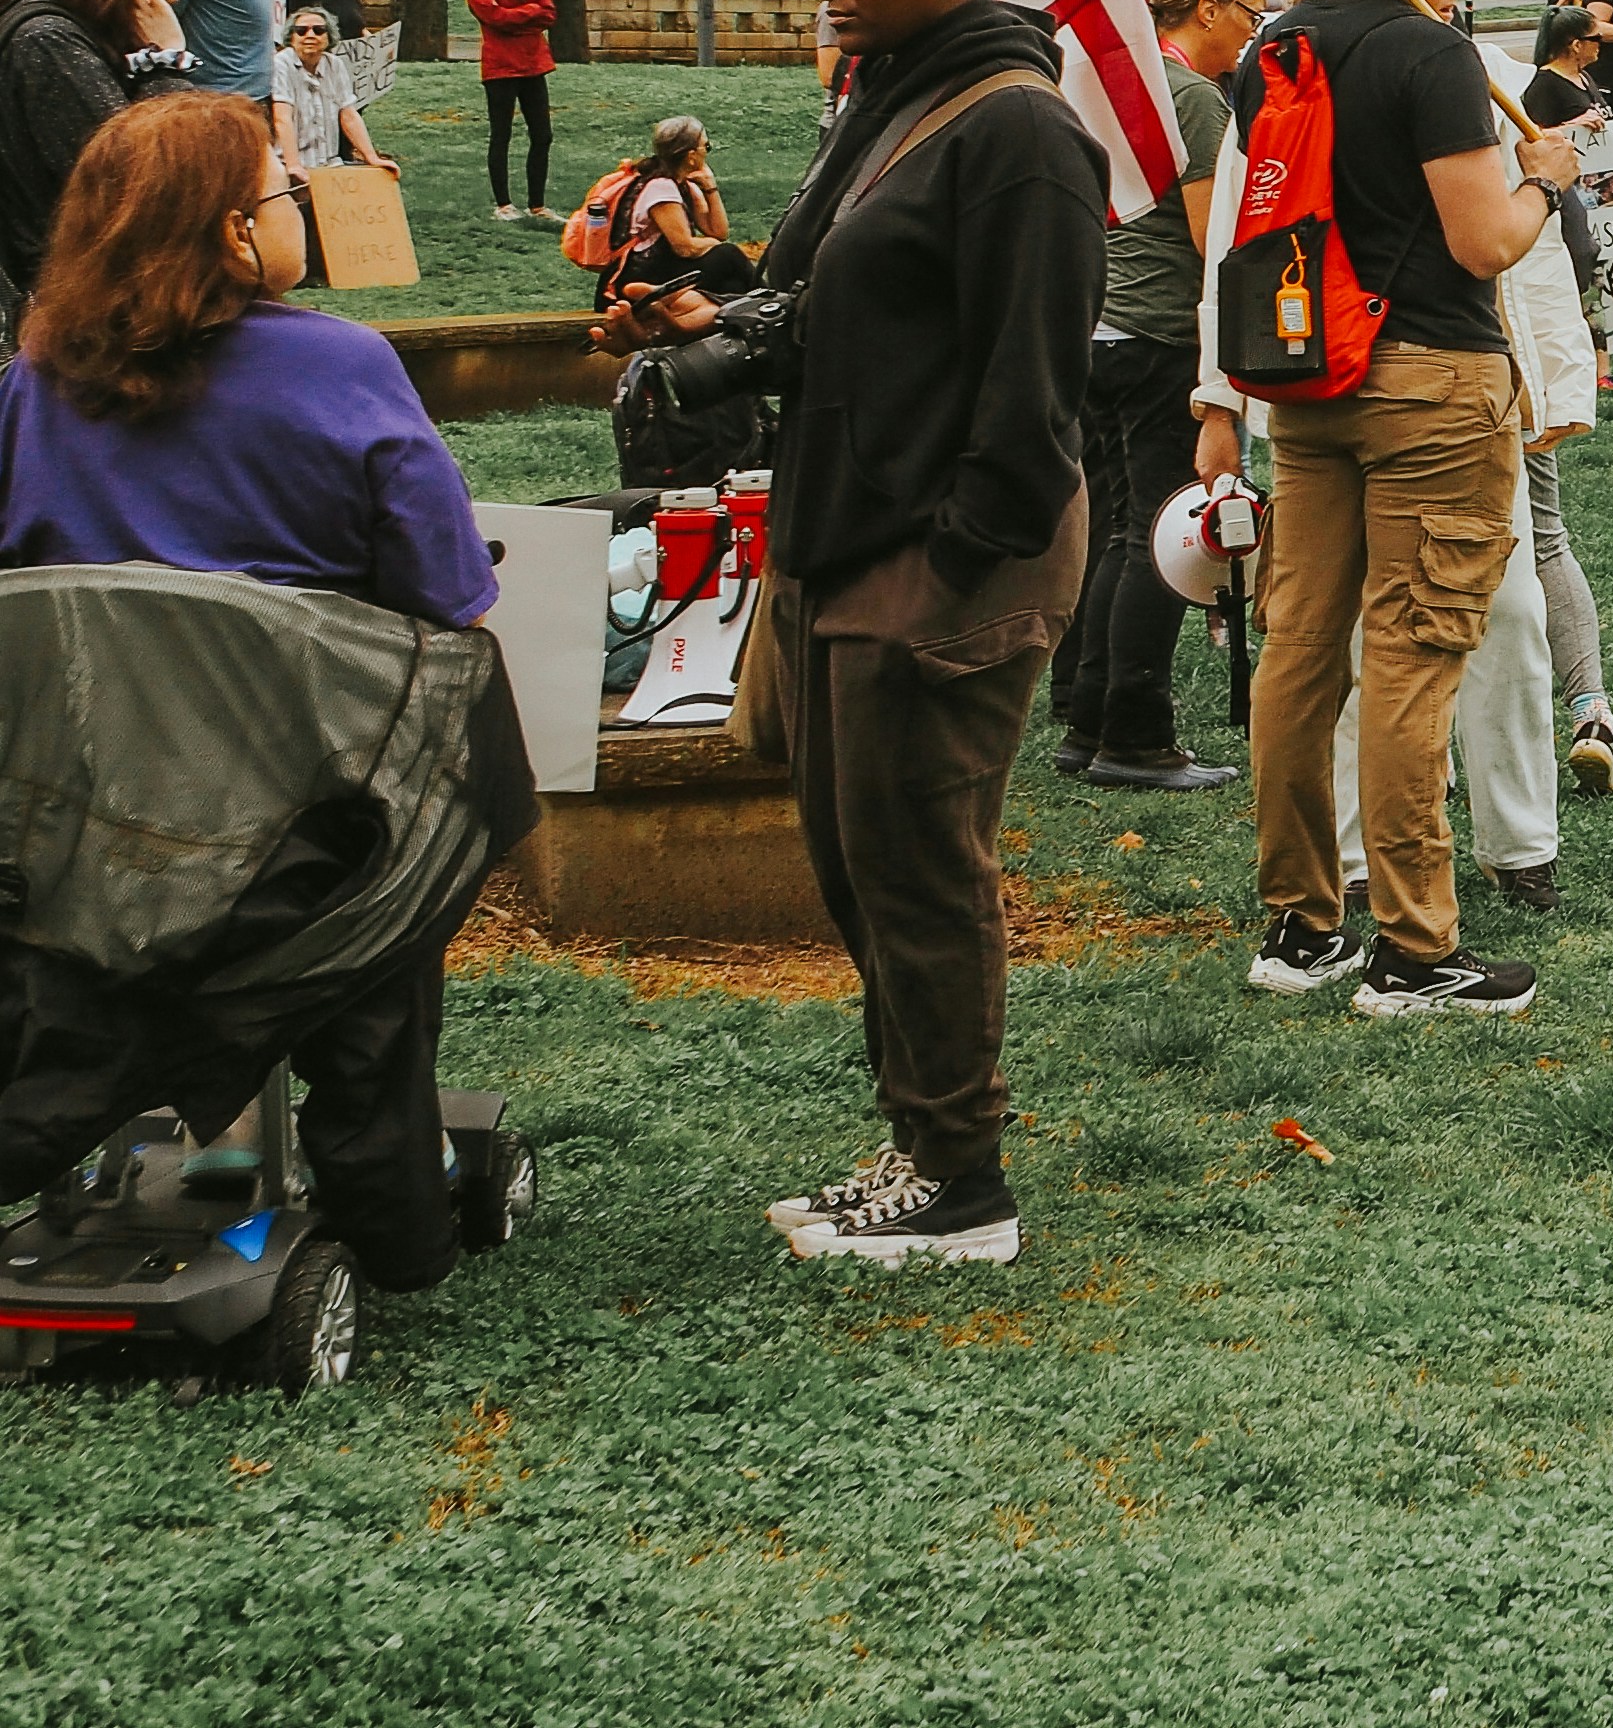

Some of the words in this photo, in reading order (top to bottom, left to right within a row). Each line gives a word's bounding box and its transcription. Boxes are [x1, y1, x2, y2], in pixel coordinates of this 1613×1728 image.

[334, 36, 376, 63] ANDS
[331, 175, 360, 195] NO
[329, 205, 388, 229] KINGS
[347, 244, 397, 267] HERE
[671, 638, 686, 673] PYLE
